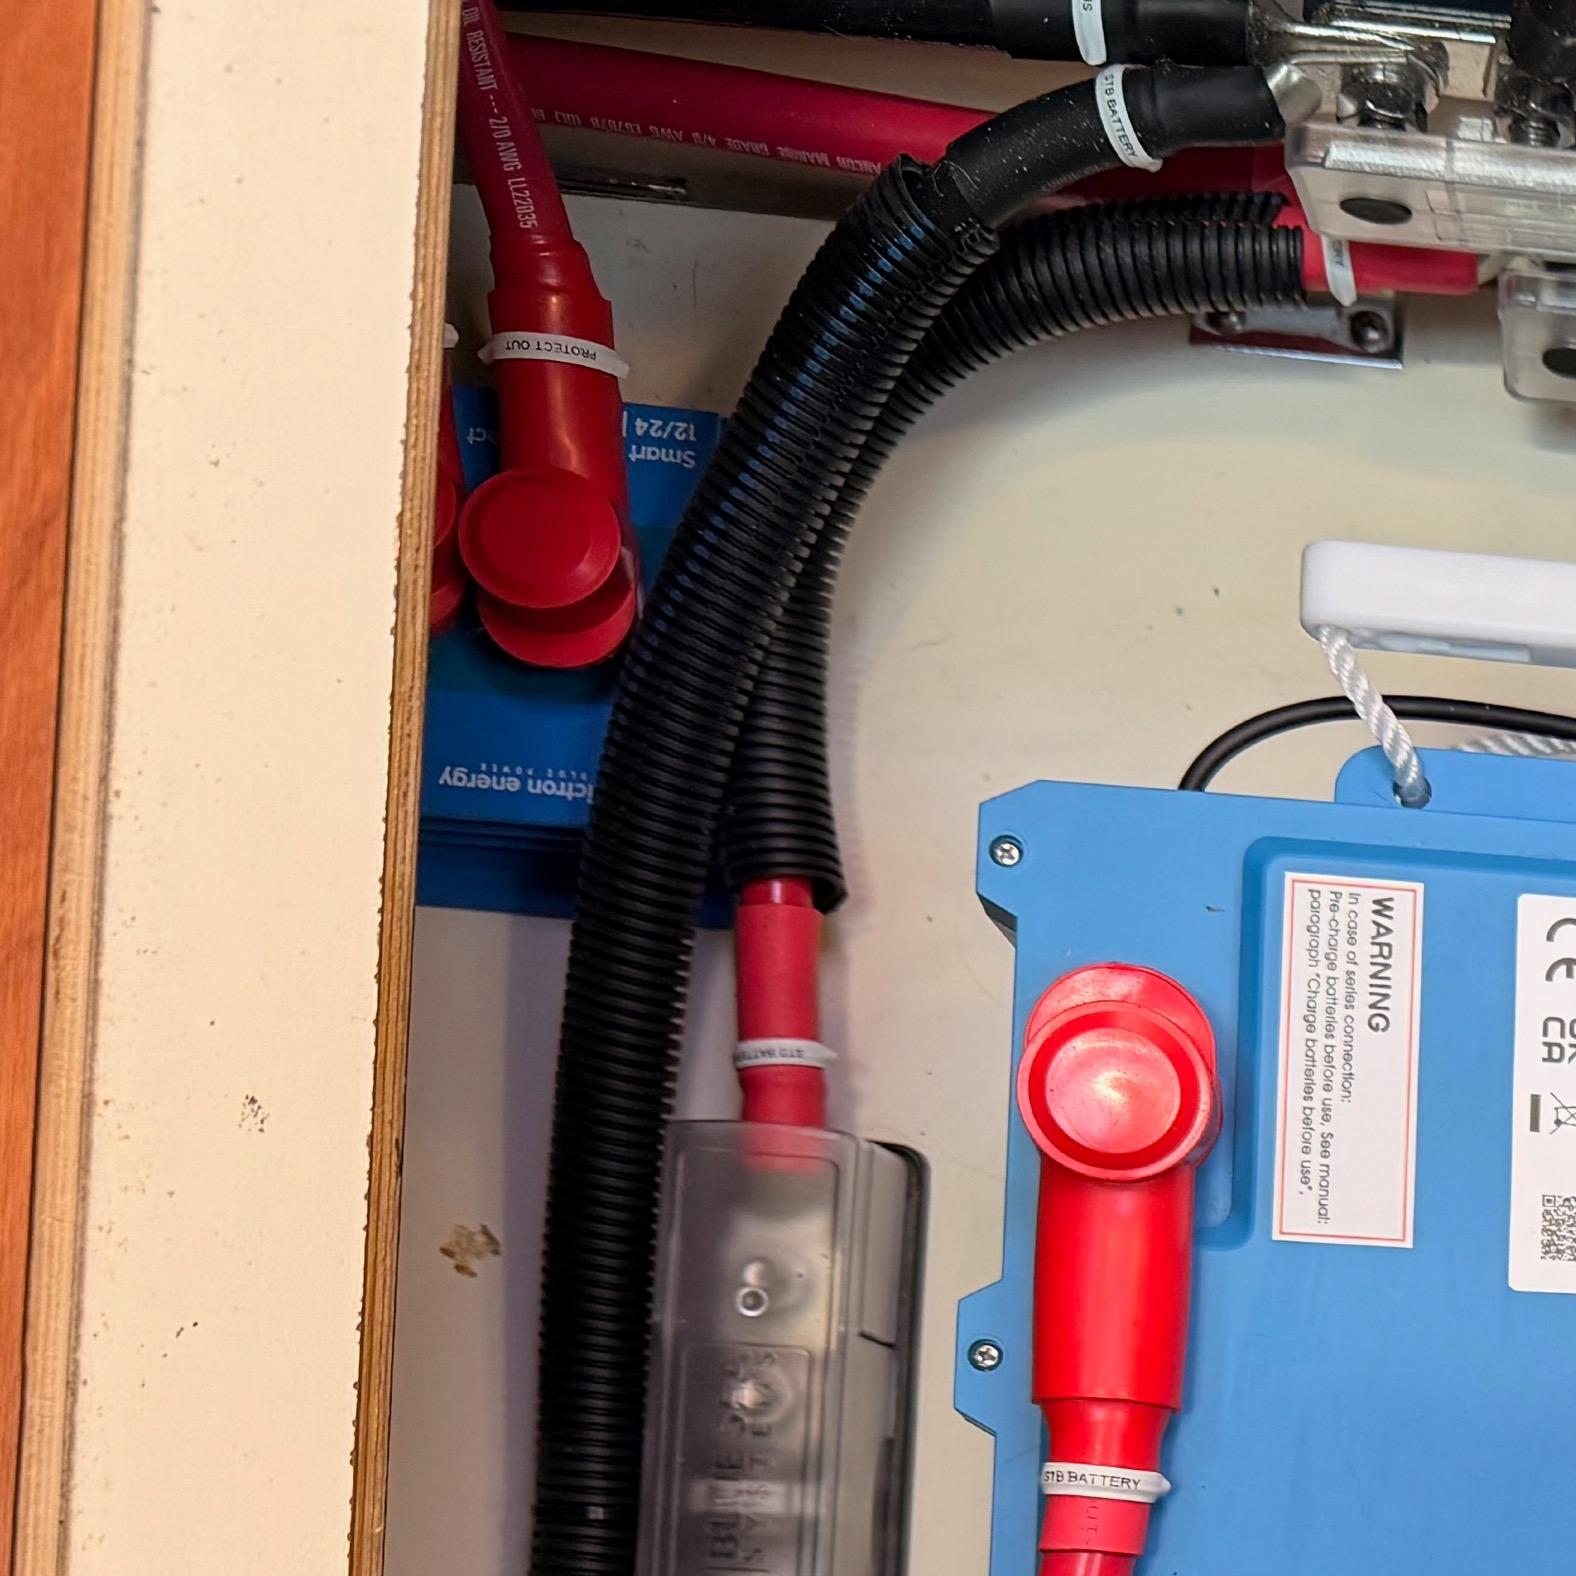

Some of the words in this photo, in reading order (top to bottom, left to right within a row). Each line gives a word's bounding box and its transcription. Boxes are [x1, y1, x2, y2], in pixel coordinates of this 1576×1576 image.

[462, 6, 481, 26] OIL
[466, 30, 498, 91] RESISTANT
[1104, 73, 1115, 97] STB
[489, 116, 512, 139] 2/0
[648, 125, 685, 143] AWG
[1107, 99, 1139, 158] BATTERY
[497, 141, 522, 171] AWG
[507, 177, 538, 229] LL22035
[505, 338, 531, 351] OUT
[536, 340, 598, 361] PROTECT
[635, 416, 697, 442] 12/24
[628, 444, 697, 470] Smart
[438, 765, 521, 793] energy
[528, 776, 595, 804] ictron
[1348, 892, 1361, 905] In
[1306, 888, 1322, 969] paragraph
[1325, 890, 1343, 972] Pre-charge
[1346, 911, 1359, 947] case
[1346, 950, 1359, 967] of
[1367, 896, 1395, 1034] WARNING
[1344, 969, 1358, 1011] series
[1324, 976, 1340, 1041] batteries
[1541, 1015, 1567, 1064] CA
[1303, 1037, 1318, 1102] batteries
[1322, 1044, 1337, 1093] before
[1341, 1014, 1355, 1103] connection:
[1301, 1105, 1316, 1156] before
[1320, 1131, 1335, 1160] See
[1317, 1163, 1332, 1225] manual:
[1067, 1470, 1142, 1491] BATTERY
